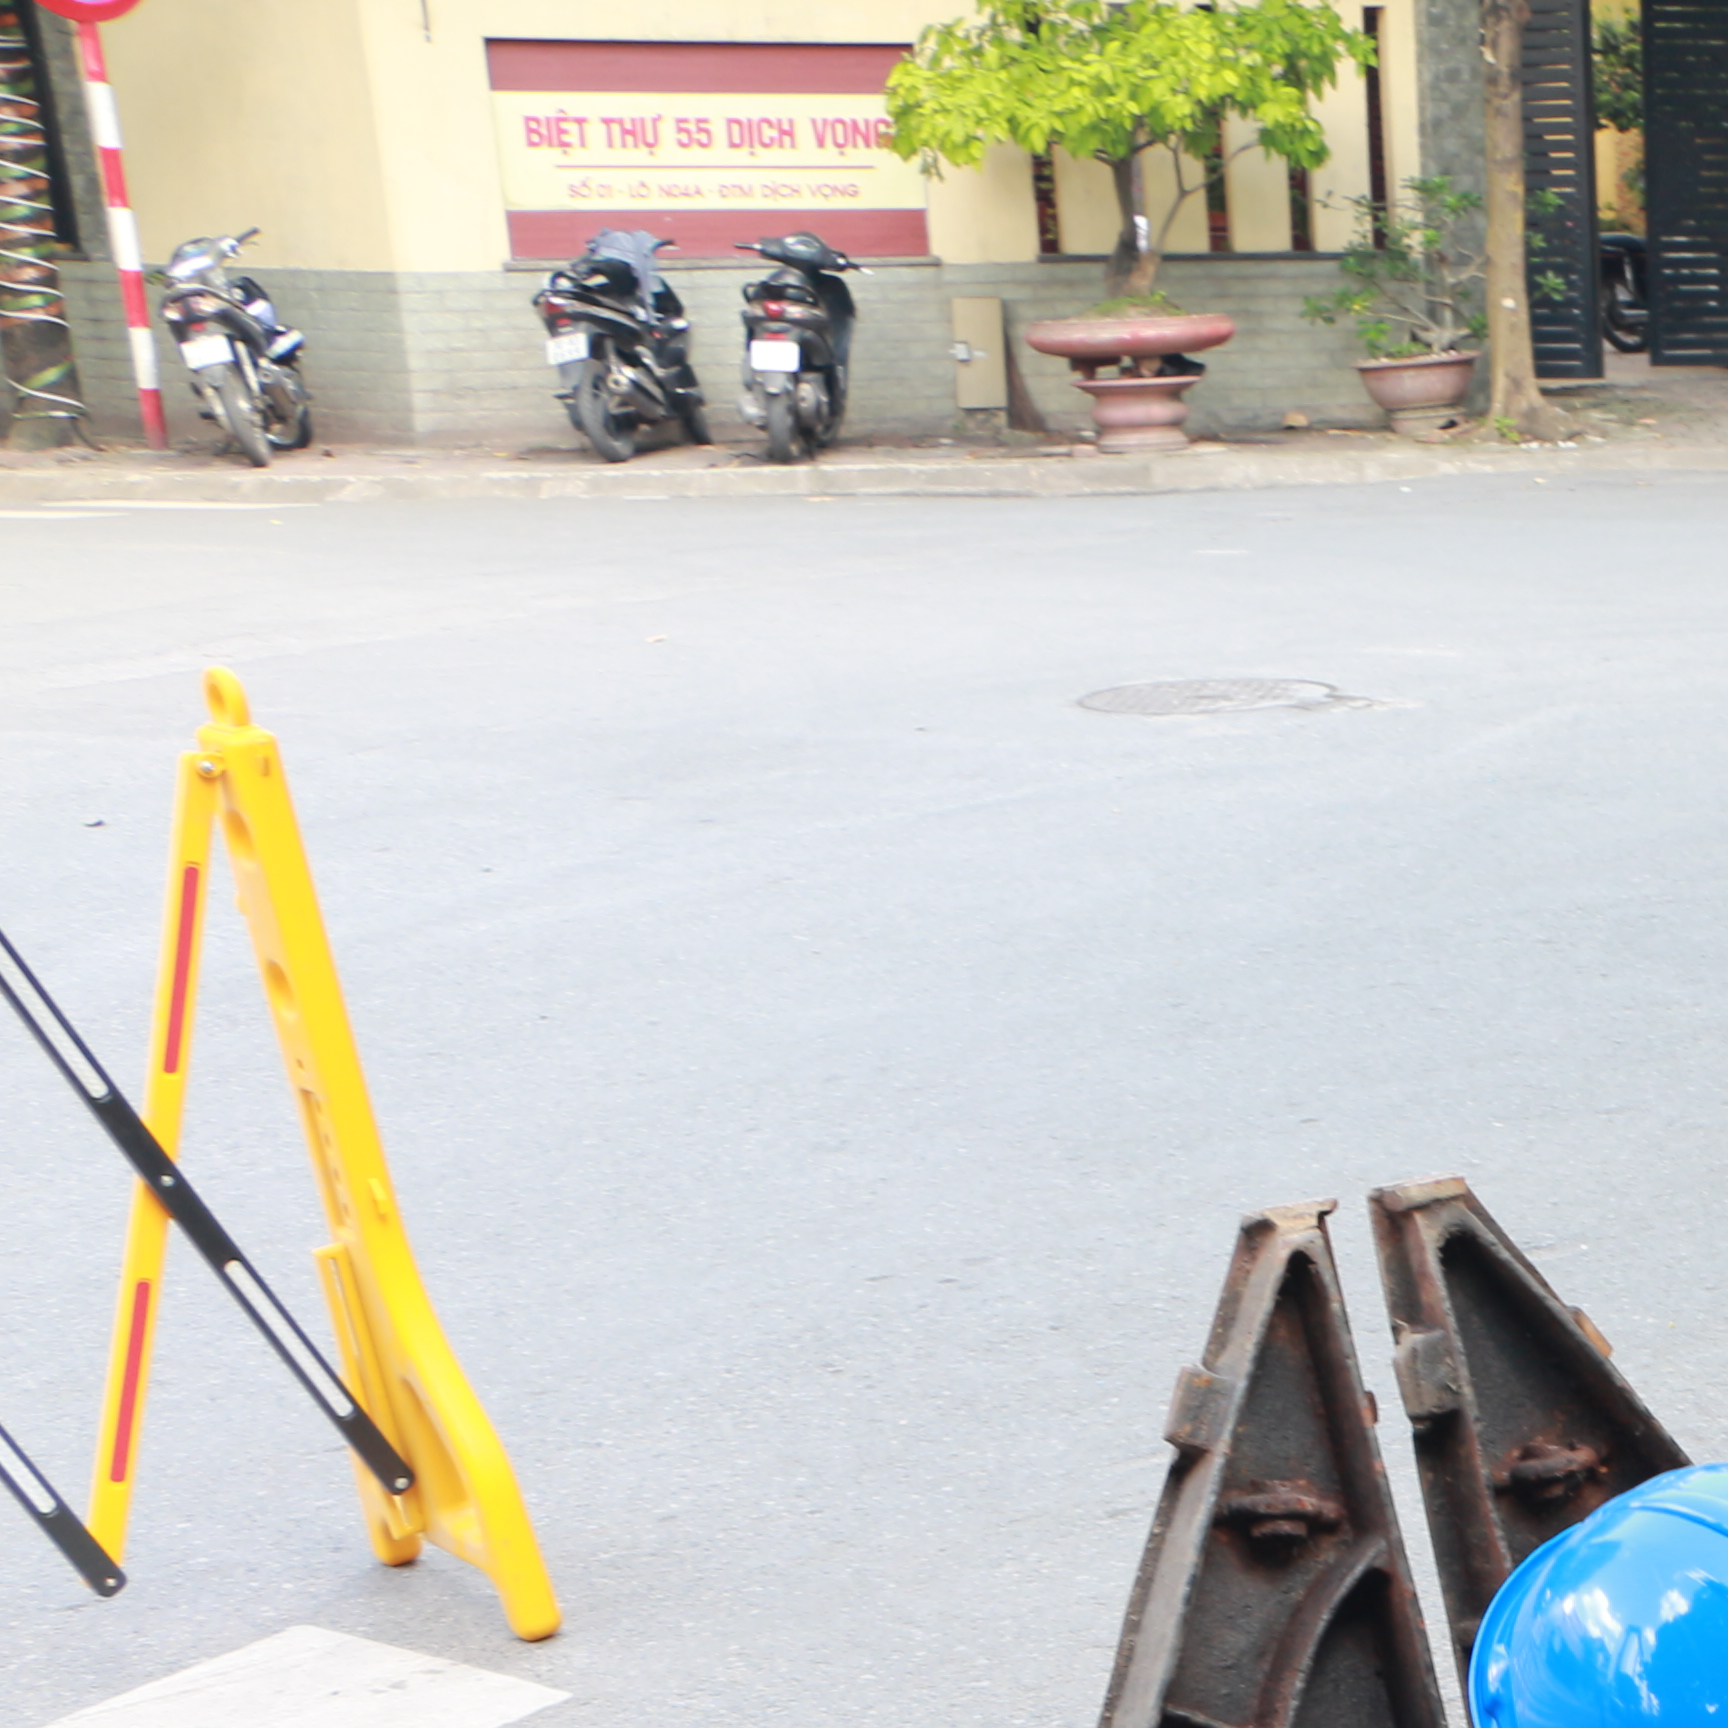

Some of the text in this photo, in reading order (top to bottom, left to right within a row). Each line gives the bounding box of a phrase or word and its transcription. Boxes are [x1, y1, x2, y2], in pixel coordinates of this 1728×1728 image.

[523, 108, 588, 156] BIỆT
[601, 113, 664, 156] THỰ
[674, 117, 713, 149] 55
[726, 117, 797, 156] DỊCH
